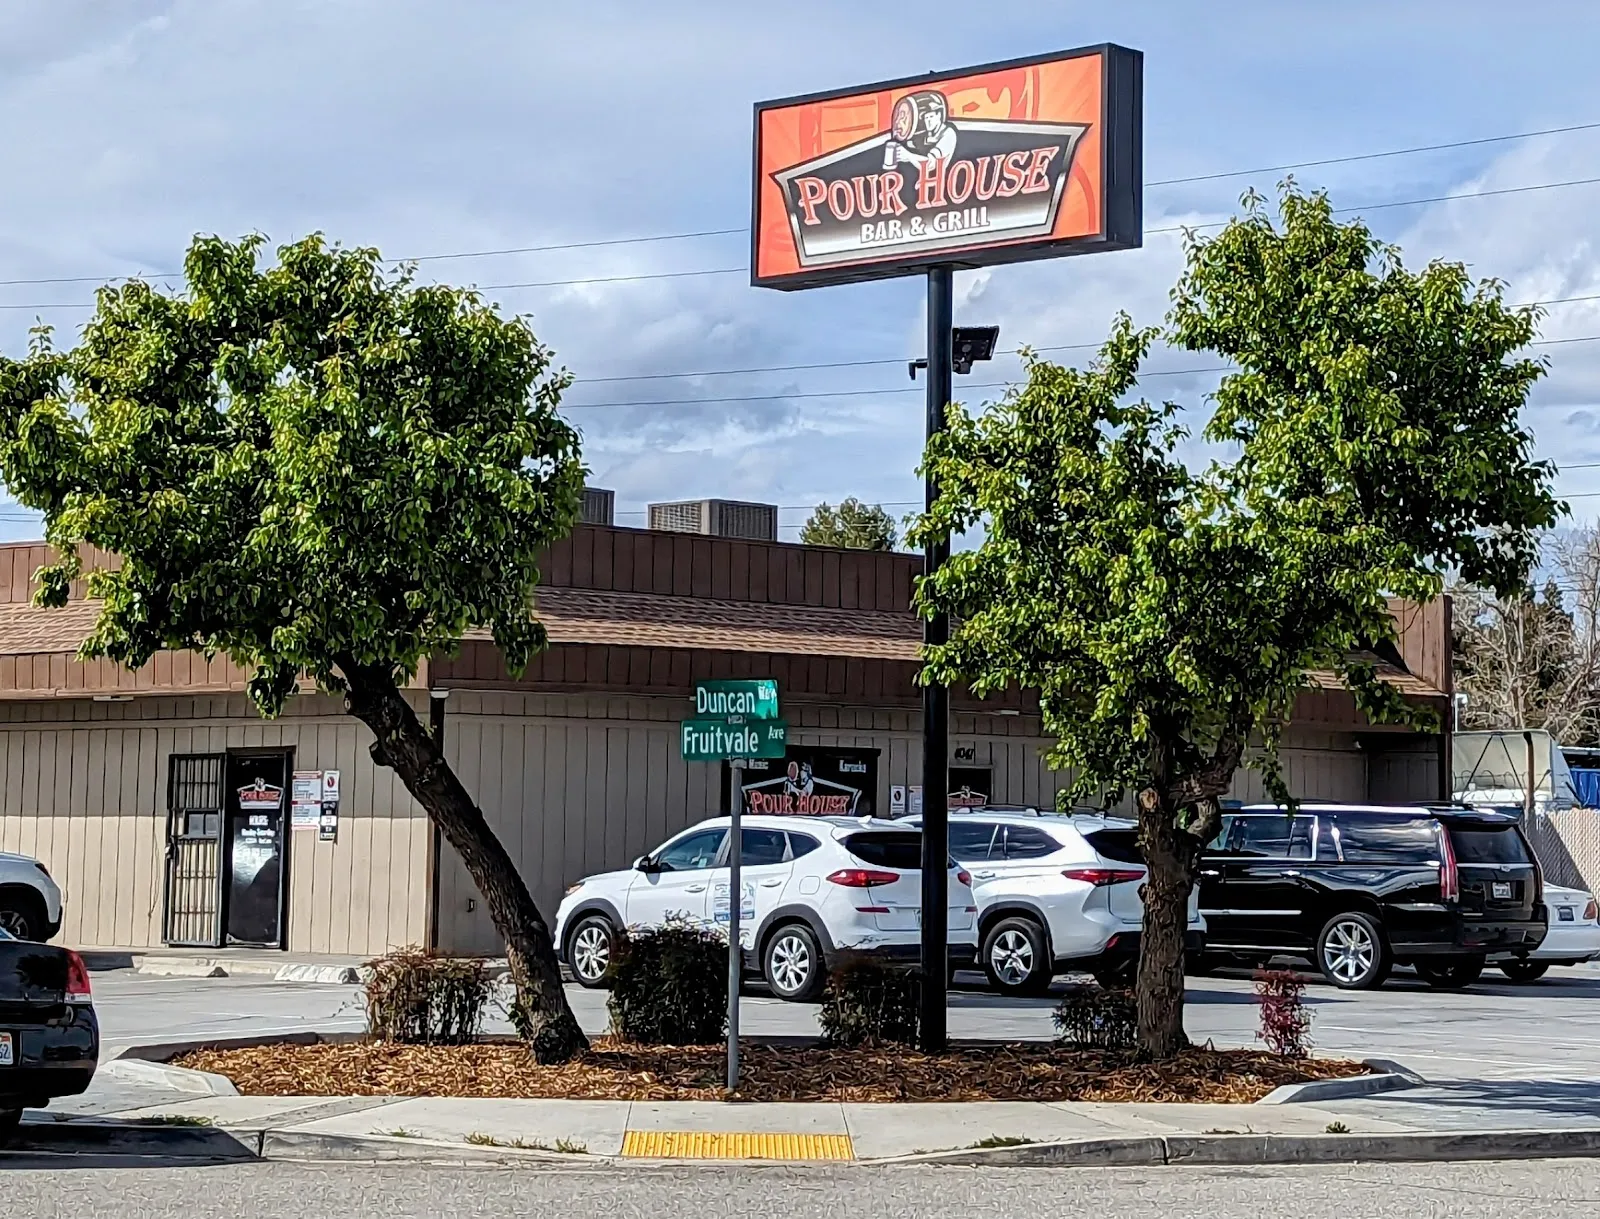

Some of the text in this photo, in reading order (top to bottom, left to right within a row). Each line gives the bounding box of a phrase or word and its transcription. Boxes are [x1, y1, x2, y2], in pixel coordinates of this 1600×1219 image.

[796, 145, 1060, 226] POUR HOUSE
[860, 206, 991, 244] BAR & GRILL
[697, 686, 756, 713] Duncan
[683, 725, 759, 754] Fruitvale
[749, 790, 794, 815] POUR
